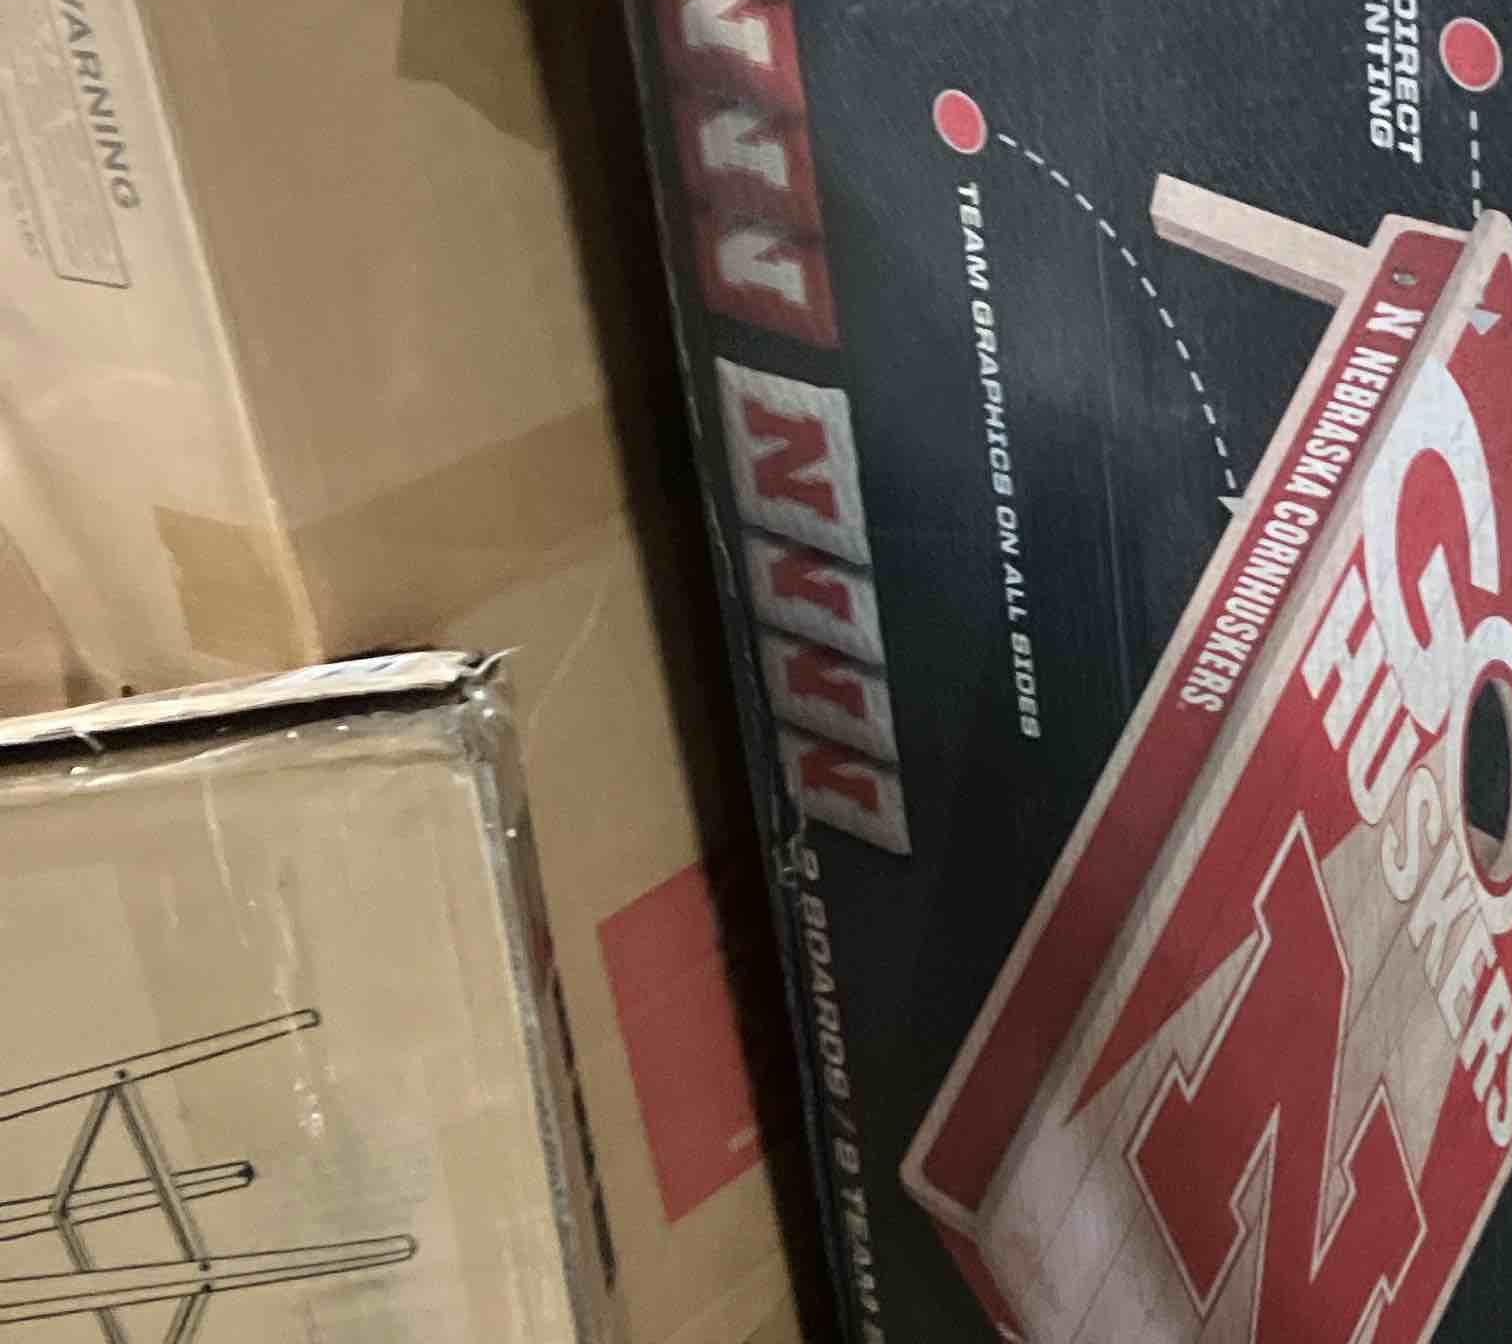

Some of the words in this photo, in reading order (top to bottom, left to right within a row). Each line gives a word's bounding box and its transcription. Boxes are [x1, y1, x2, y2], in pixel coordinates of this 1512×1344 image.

[957, 181, 990, 291] TEAM
[1366, 301, 1425, 340] N
[970, 299, 1014, 496] GRAPHICS
[1284, 346, 1400, 499] NEBRASKA
[996, 505, 1021, 556] ON
[1001, 561, 1028, 624] ALL
[1179, 499, 1320, 713] CORNHUSKERS
[1010, 631, 1041, 739] SIDES
[801, 891, 851, 1099] BOARDS
